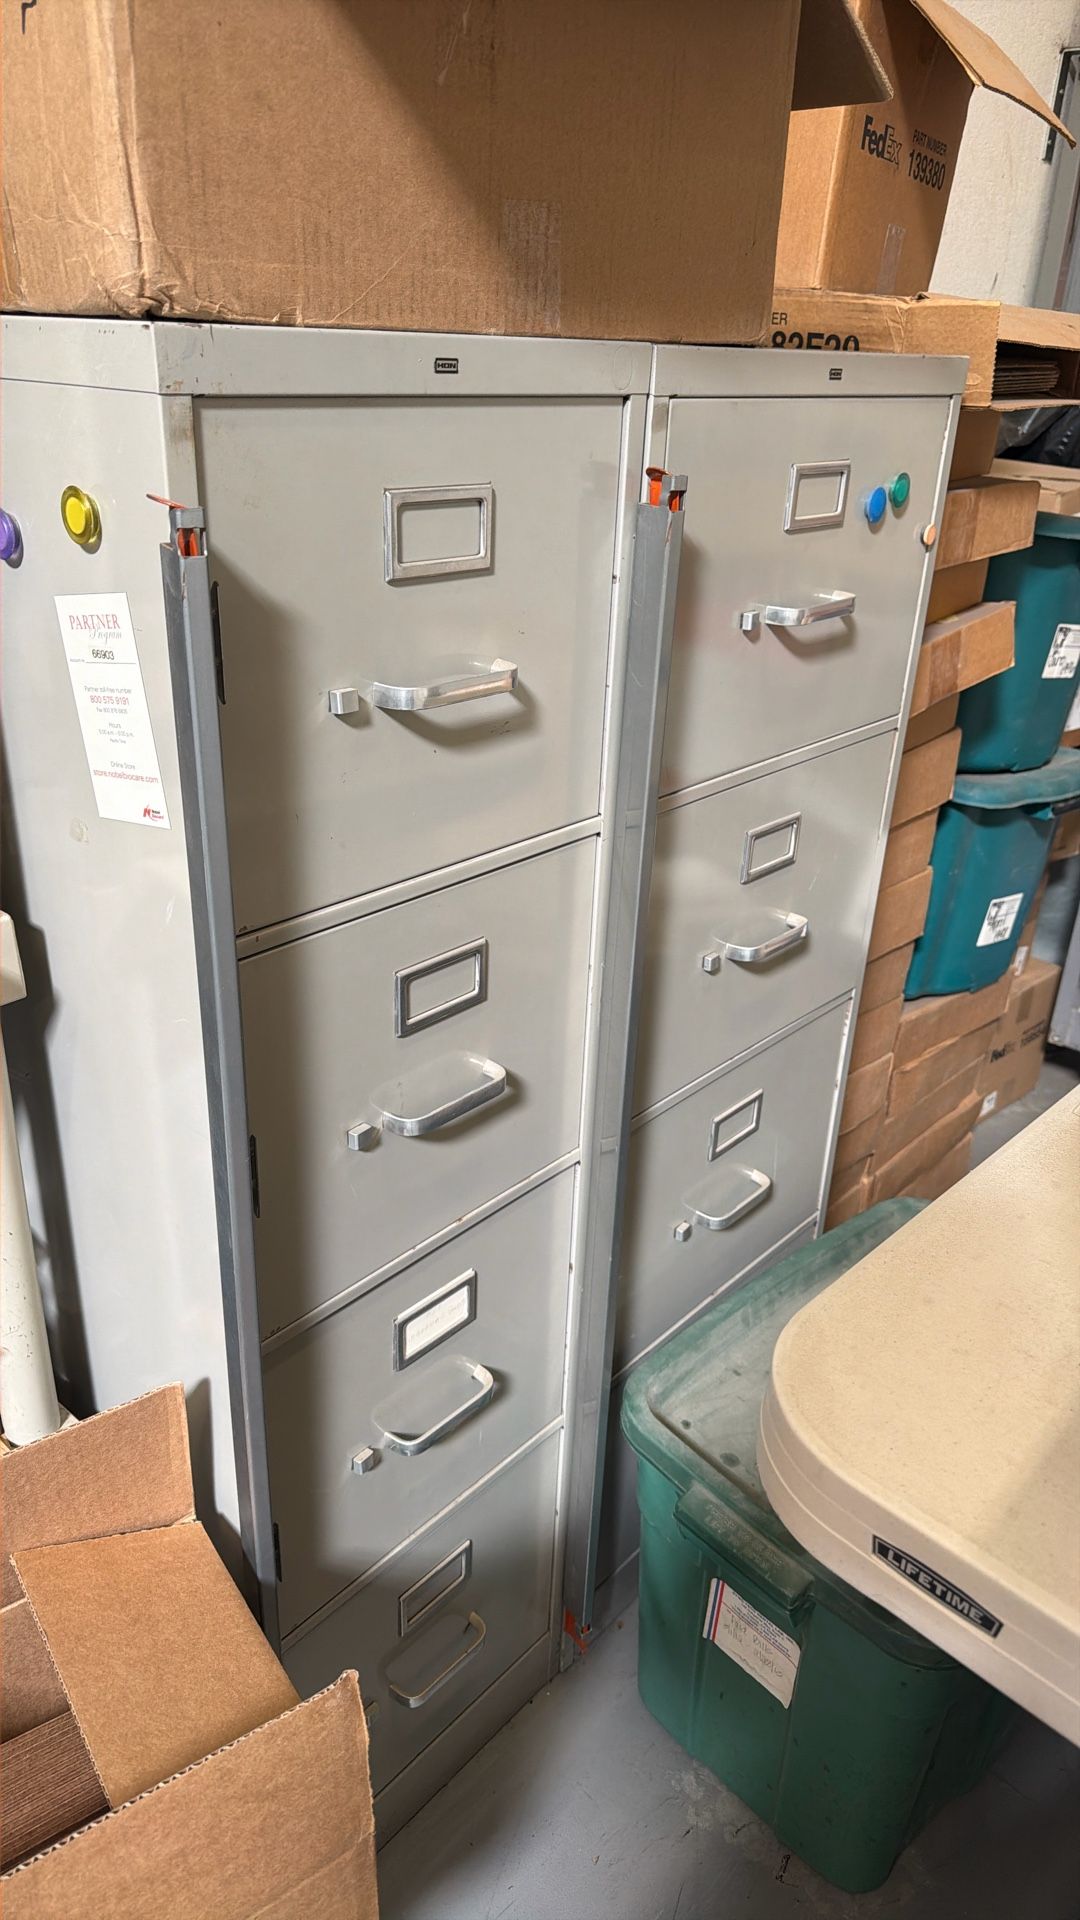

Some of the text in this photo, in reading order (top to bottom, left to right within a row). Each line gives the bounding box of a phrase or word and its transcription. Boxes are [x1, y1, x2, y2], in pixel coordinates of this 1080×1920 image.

[861, 114, 902, 165] FedEx
[913, 129, 948, 157] PART NUMBER
[908, 149, 946, 191] 139380
[68, 614, 121, 630] PARTNER
[90, 695, 102, 704] 800
[103, 695, 115, 704] 575
[887, 1549, 984, 1623] LIFETIME
